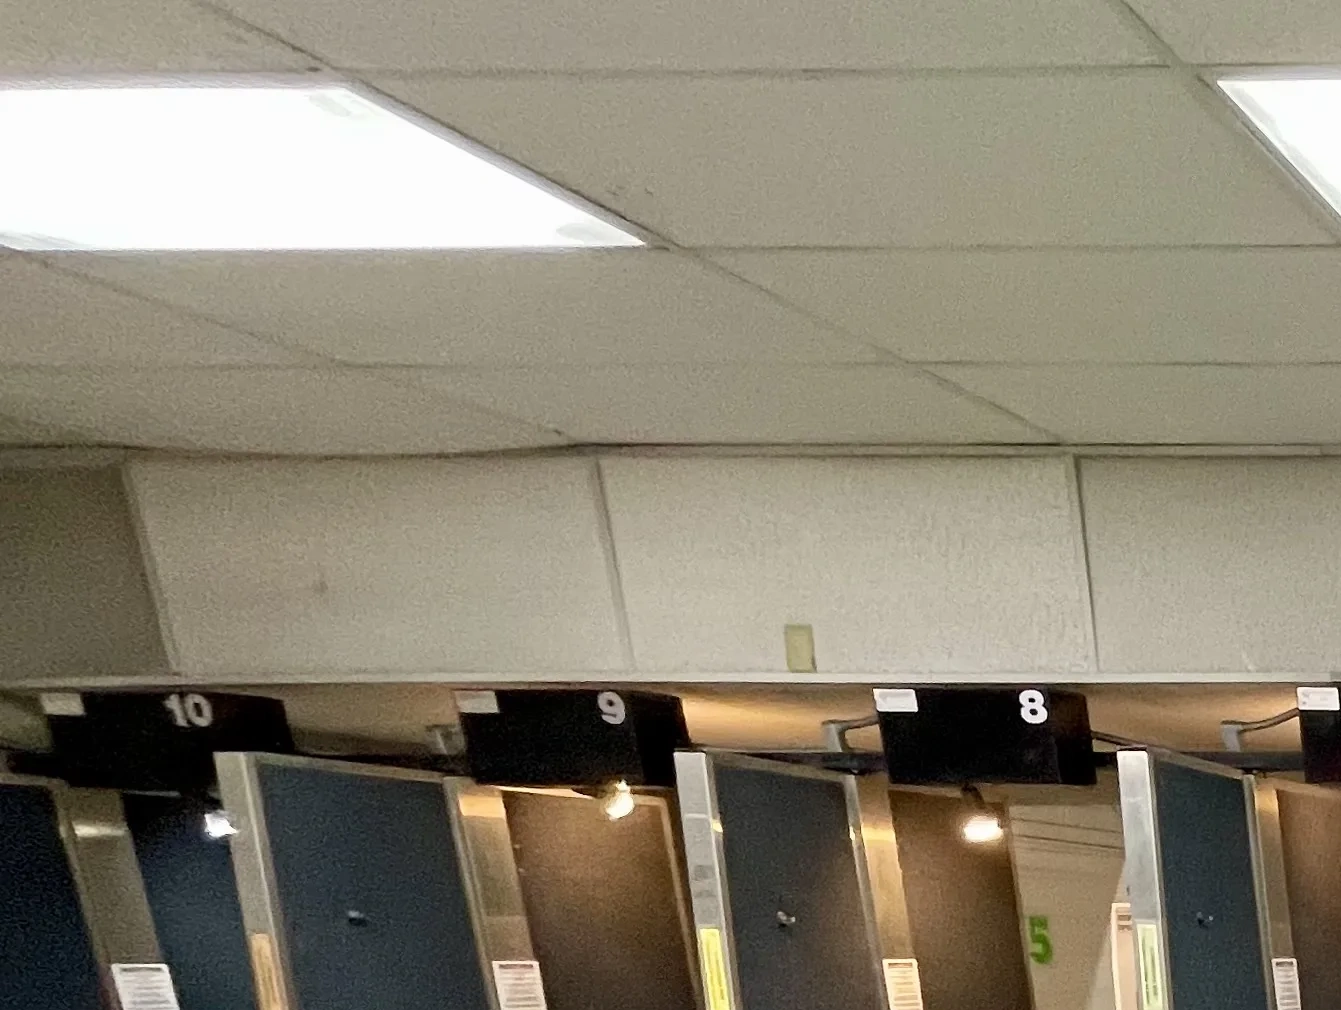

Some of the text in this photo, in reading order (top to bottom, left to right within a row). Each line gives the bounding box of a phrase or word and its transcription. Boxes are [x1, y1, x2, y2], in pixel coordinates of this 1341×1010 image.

[162, 693, 213, 728] 10
[597, 691, 626, 725] 9
[1018, 689, 1048, 724] 8
[1028, 915, 1053, 965] 5
